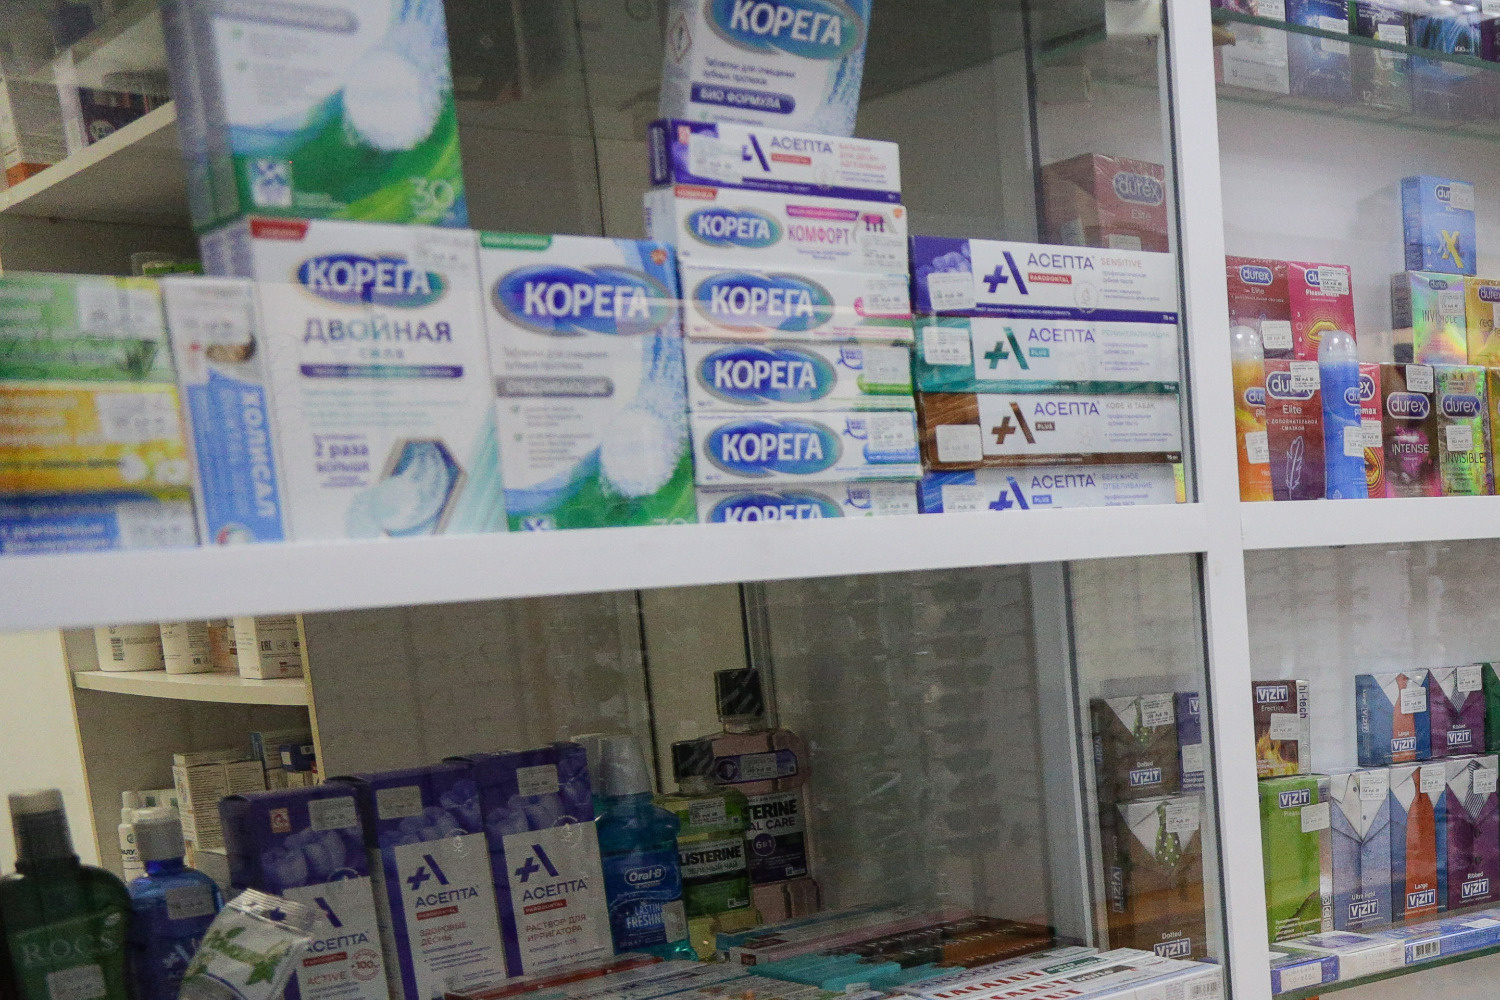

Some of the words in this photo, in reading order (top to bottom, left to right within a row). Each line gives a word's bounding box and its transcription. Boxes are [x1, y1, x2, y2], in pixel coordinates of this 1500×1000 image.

[730, 0, 841, 46] КОРЕГА
[770, 136, 834, 154] АСЕПТА
[698, 214, 771, 240] КОРЕГА
[788, 225, 850, 245] КОМФОРТ
[1027, 253, 1094, 270] АСЕПТА
[305, 259, 433, 295] КОРЕГА
[1242, 268, 1269, 281] durex
[523, 281, 652, 321] КОРЕГА
[710, 286, 814, 317] КОРЕГА
[303, 315, 453, 343] ДВОЙНАЯ
[1027, 328, 1096, 344] АСЕПТА
[714, 359, 817, 390] КОРЕГА
[1033, 402, 1100, 417] АСЕПТА
[1282, 405, 1302, 414] Elite
[1391, 395, 1426, 413] durex
[1445, 396, 1478, 413] durex
[721, 433, 825, 462] КОРЕГА
[1392, 444, 1429, 454] INTENSE
[1031, 474, 1096, 490] АСЕПТА
[680, 845, 742, 866] LISTERINE
[628, 867, 663, 883] Oral-B
[415, 887, 479, 908] АСЕПТА
[522, 880, 588, 902] АСЕПТА
[419, 921, 467, 937] ЗДОРОВЫЕ
[525, 918, 565, 933] РАСТВОР
[567, 914, 587, 925] ДЛЯ
[421, 934, 452, 947] ДЕСНЫ
[527, 925, 583, 943] ИРРИГАТОРА
[307, 971, 347, 985] ACTIVE
[933, 970, 1044, 998] LACALUT
